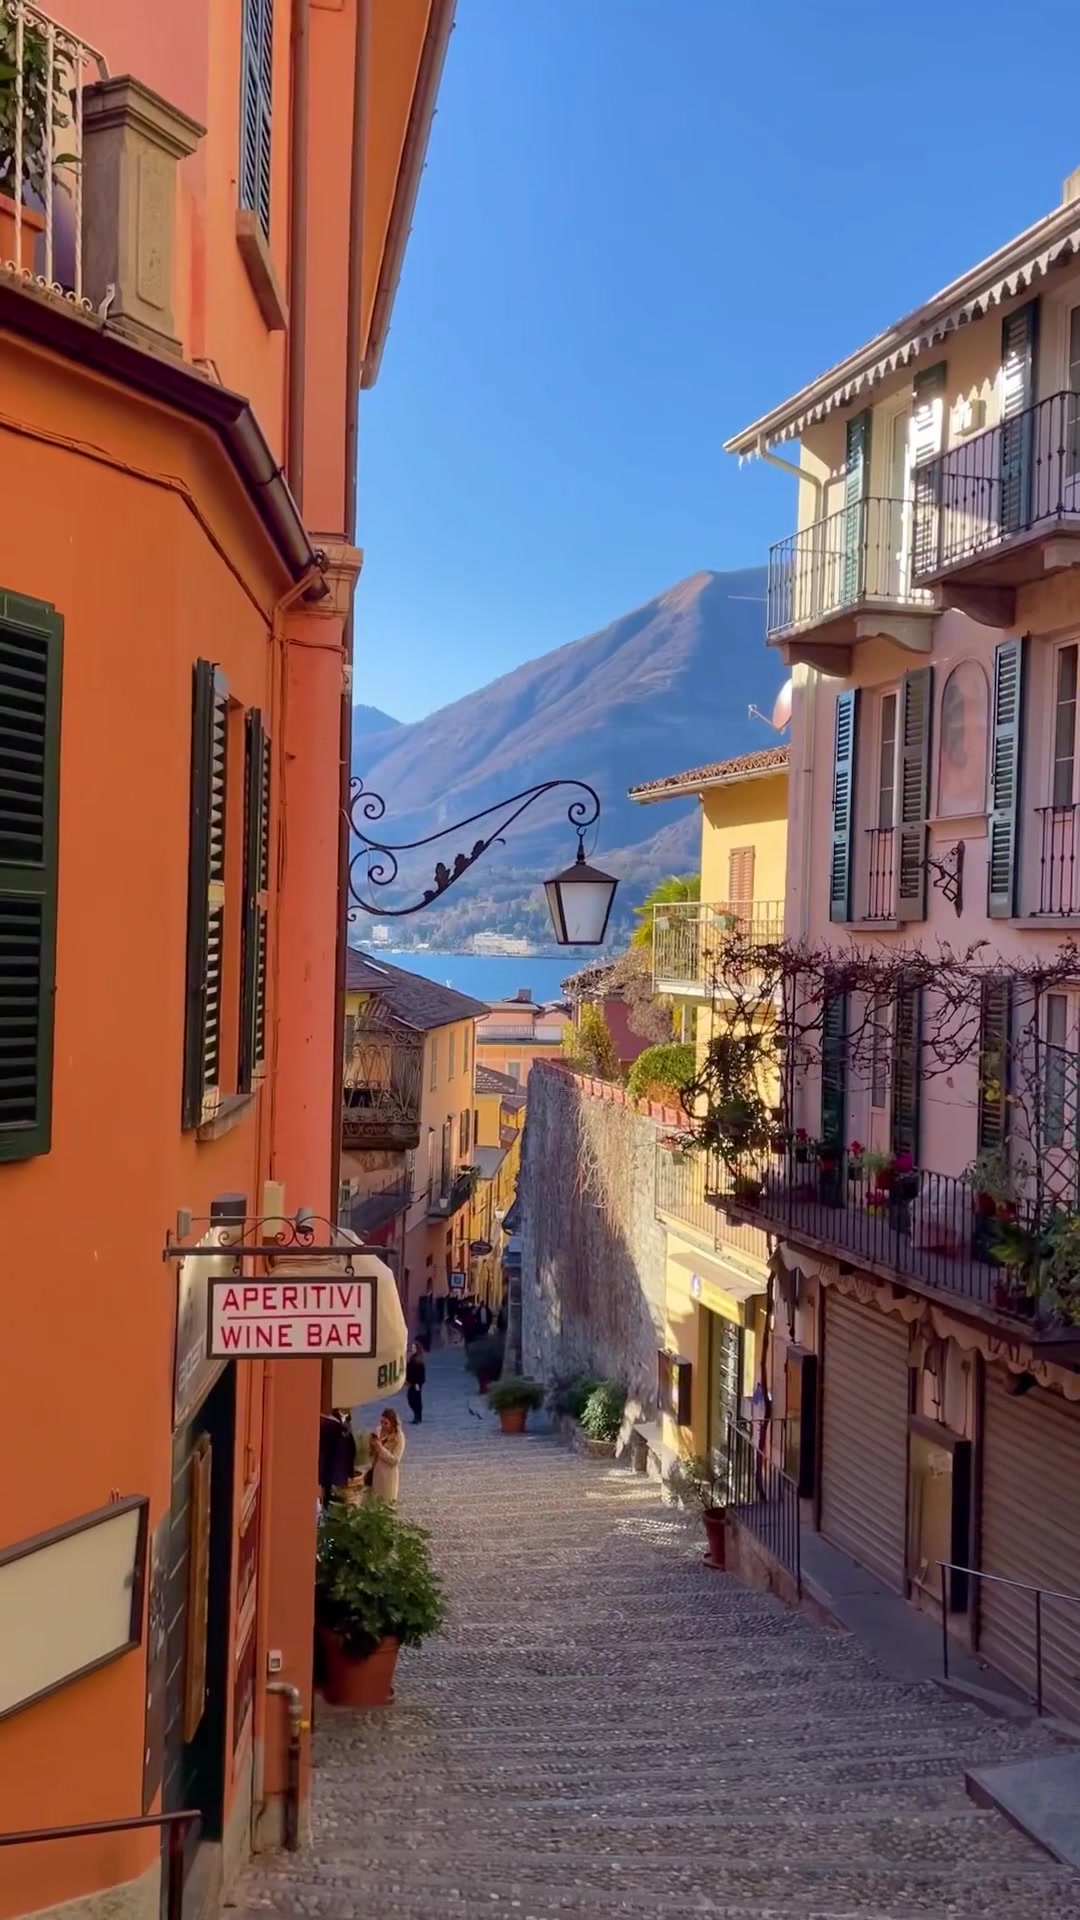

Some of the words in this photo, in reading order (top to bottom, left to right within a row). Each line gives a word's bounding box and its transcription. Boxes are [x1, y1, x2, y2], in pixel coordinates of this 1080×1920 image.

[222, 1285, 362, 1311] APERITIVI
[220, 1324, 293, 1349] WINE
[306, 1323, 363, 1347] BAR
